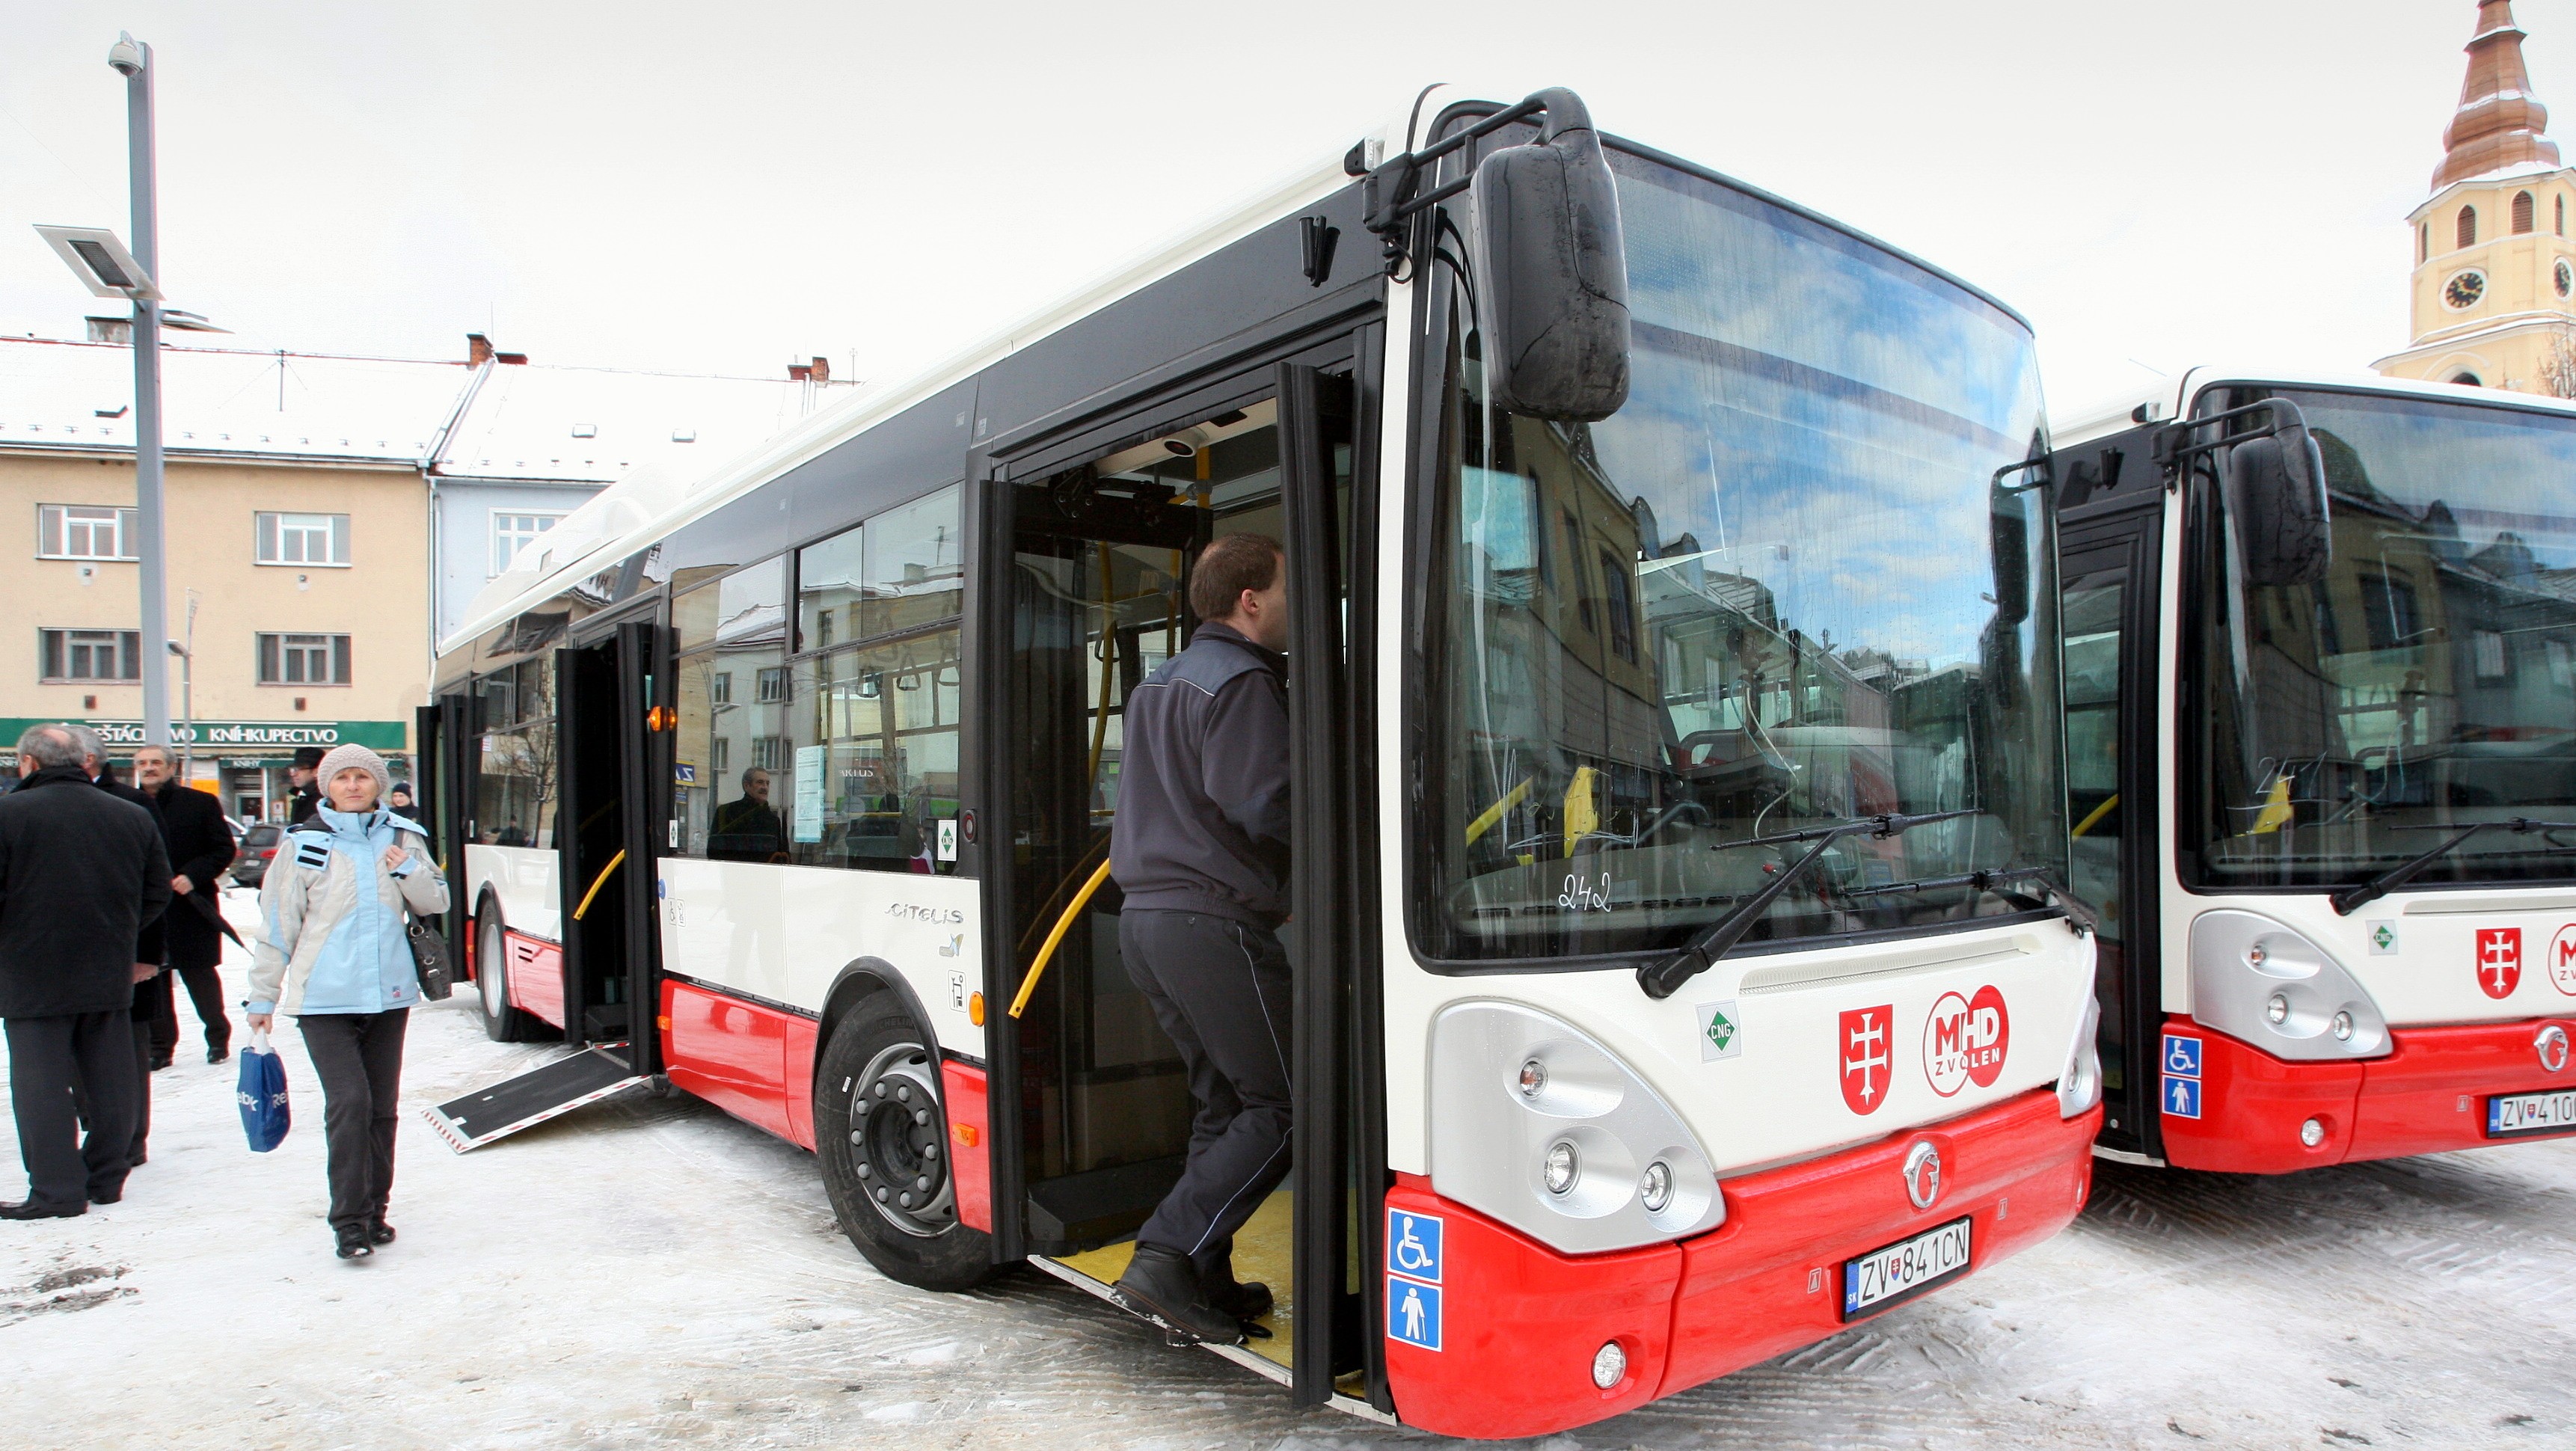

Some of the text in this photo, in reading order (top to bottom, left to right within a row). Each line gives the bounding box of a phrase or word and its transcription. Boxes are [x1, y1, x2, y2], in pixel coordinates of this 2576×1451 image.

[209, 726, 338, 743] KNÍHKUPECTVO
[2255, 750, 2328, 800] 241
[1558, 872, 1613, 912] 242
[2375, 932, 2392, 942] CNG
[1711, 1022, 1732, 1040] CNG
[1936, 1006, 2000, 1057] MHD
[1936, 1047, 2000, 1076] ZVOLEN
[1847, 1291, 1857, 1304] SK
